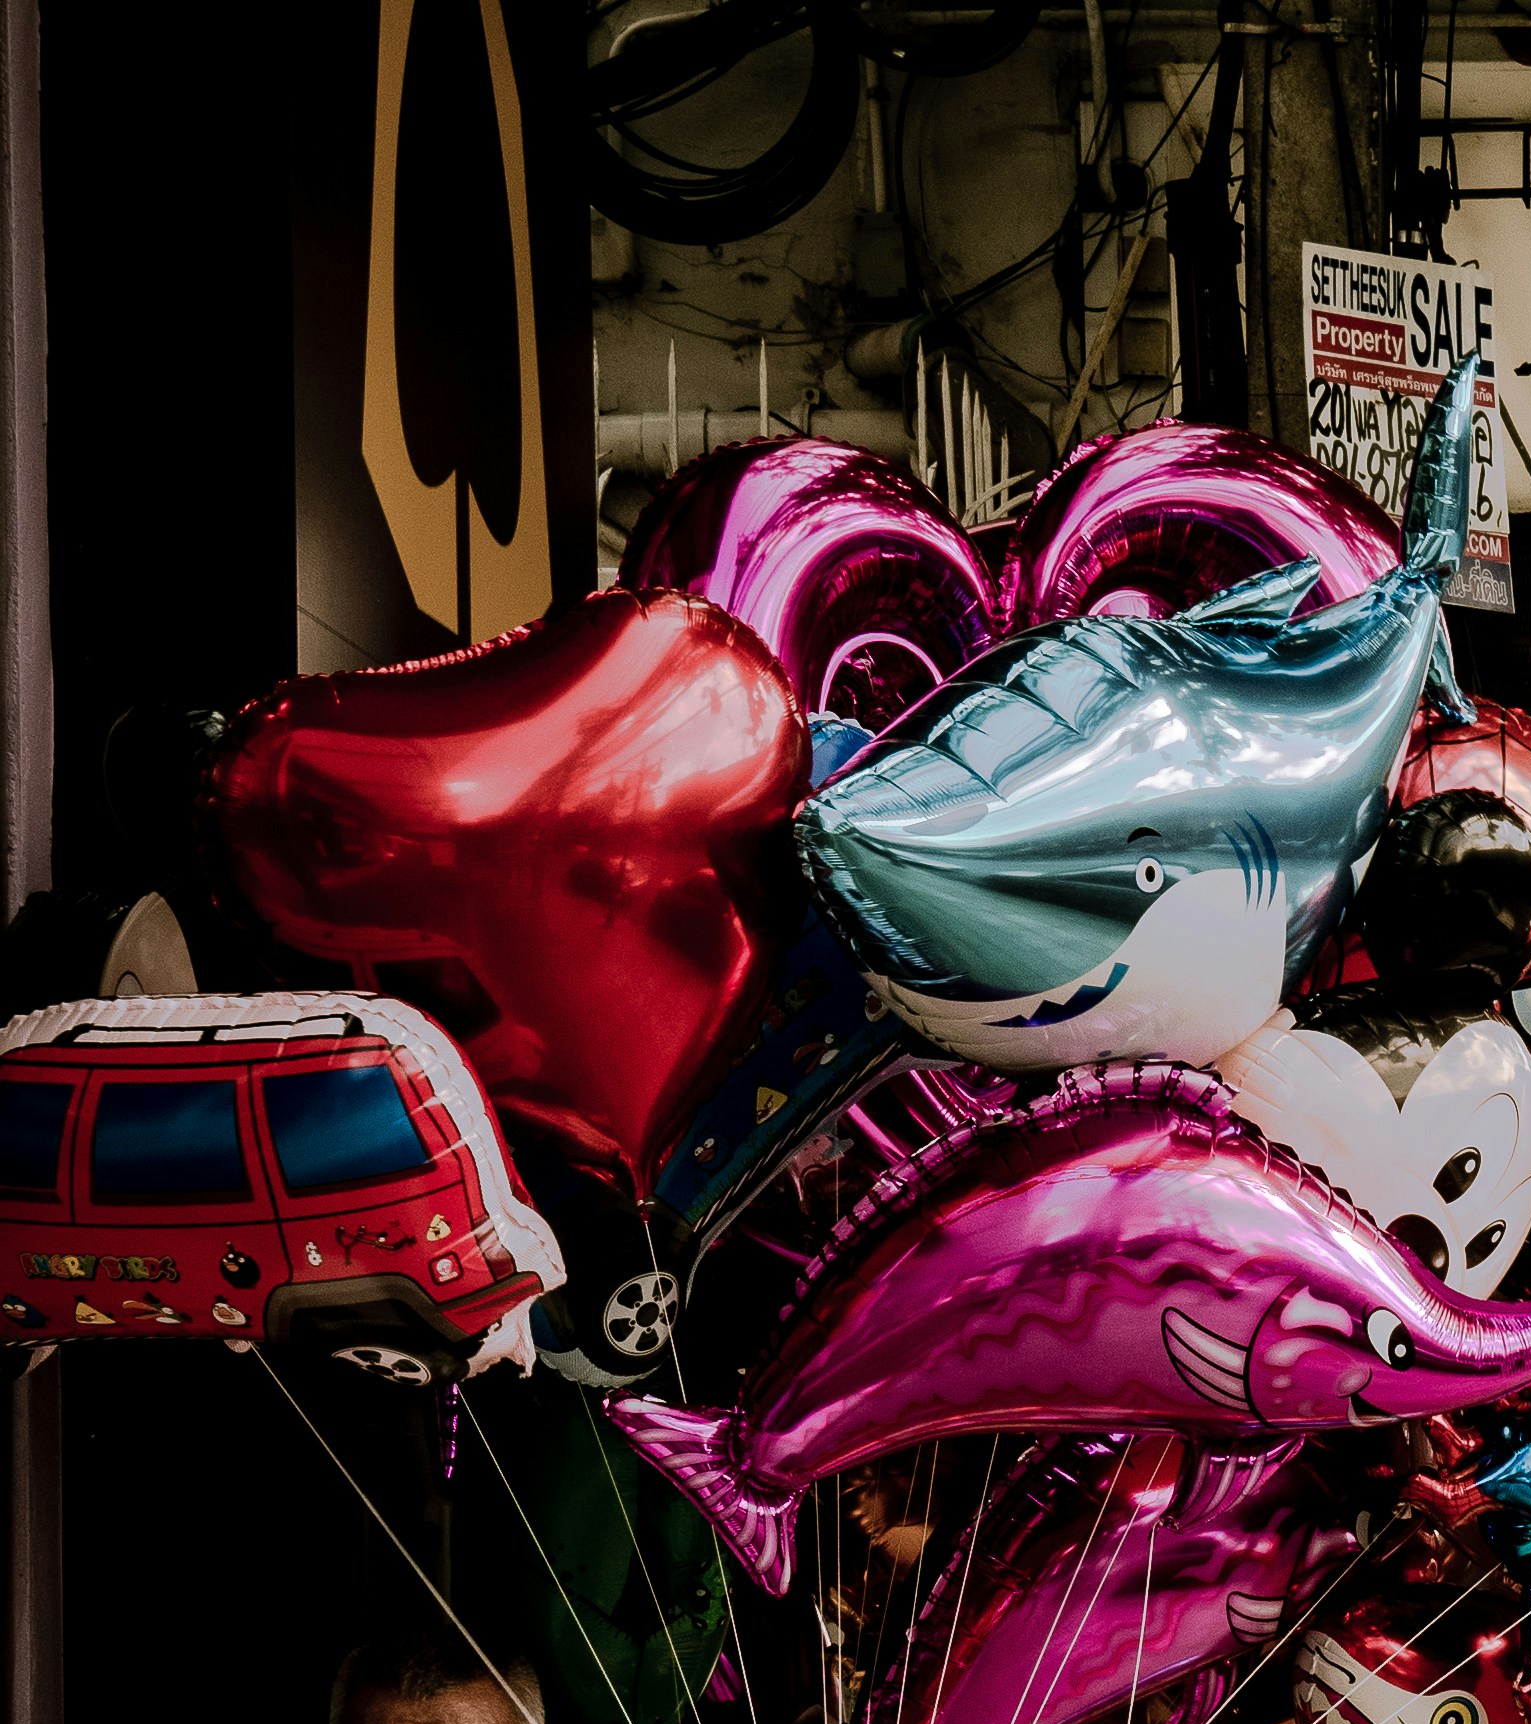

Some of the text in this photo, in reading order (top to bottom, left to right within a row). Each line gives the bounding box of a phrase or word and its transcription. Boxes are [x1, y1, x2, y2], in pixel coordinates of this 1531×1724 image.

[1311, 253, 1496, 378] SETTHEESUK SALE
[1316, 316, 1404, 362] Property
[1316, 362, 1348, 379] บริษัท
